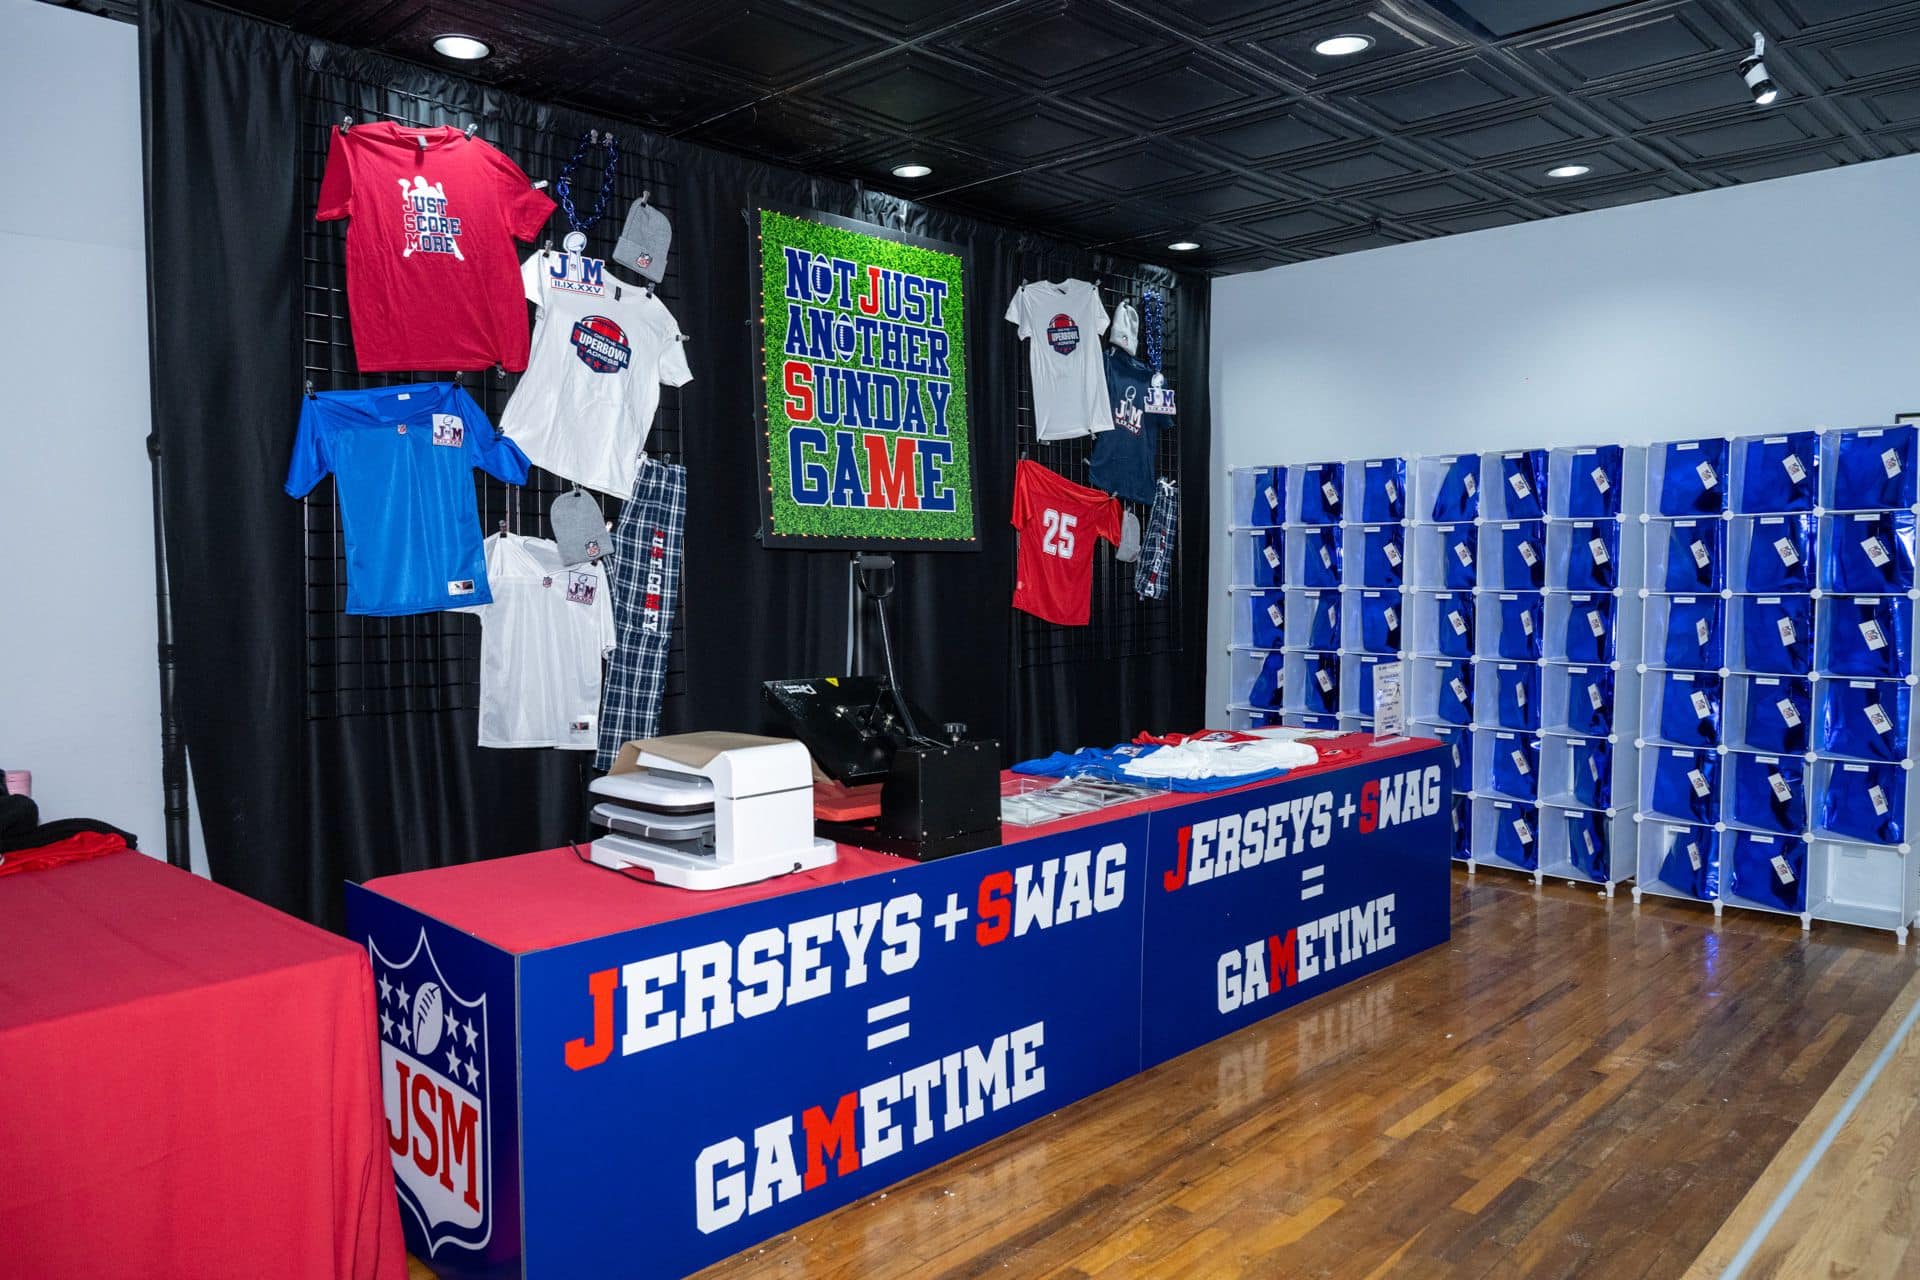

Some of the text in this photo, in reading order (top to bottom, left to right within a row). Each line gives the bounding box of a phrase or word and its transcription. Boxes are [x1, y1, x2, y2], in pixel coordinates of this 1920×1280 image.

[403, 195, 448, 214] JUST
[404, 213, 461, 235] SCORE
[406, 234, 455, 253] MORE
[858, 266, 947, 328] JUST
[573, 328, 628, 365] SUPERBOWL
[784, 303, 950, 378] ANOTHER
[784, 360, 951, 437] SUNDAY
[788, 426, 956, 512] GAME
[1042, 508, 1078, 559] 25
[642, 573, 661, 632] COMFY
[1163, 764, 1441, 892] JERSEYS + SWAG
[565, 842, 1127, 1071] JERSEYS + SWAG
[1217, 893, 1396, 1015] GAMETIME
[386, 1059, 480, 1214] JSM
[695, 1021, 1045, 1235] GAMETIME
